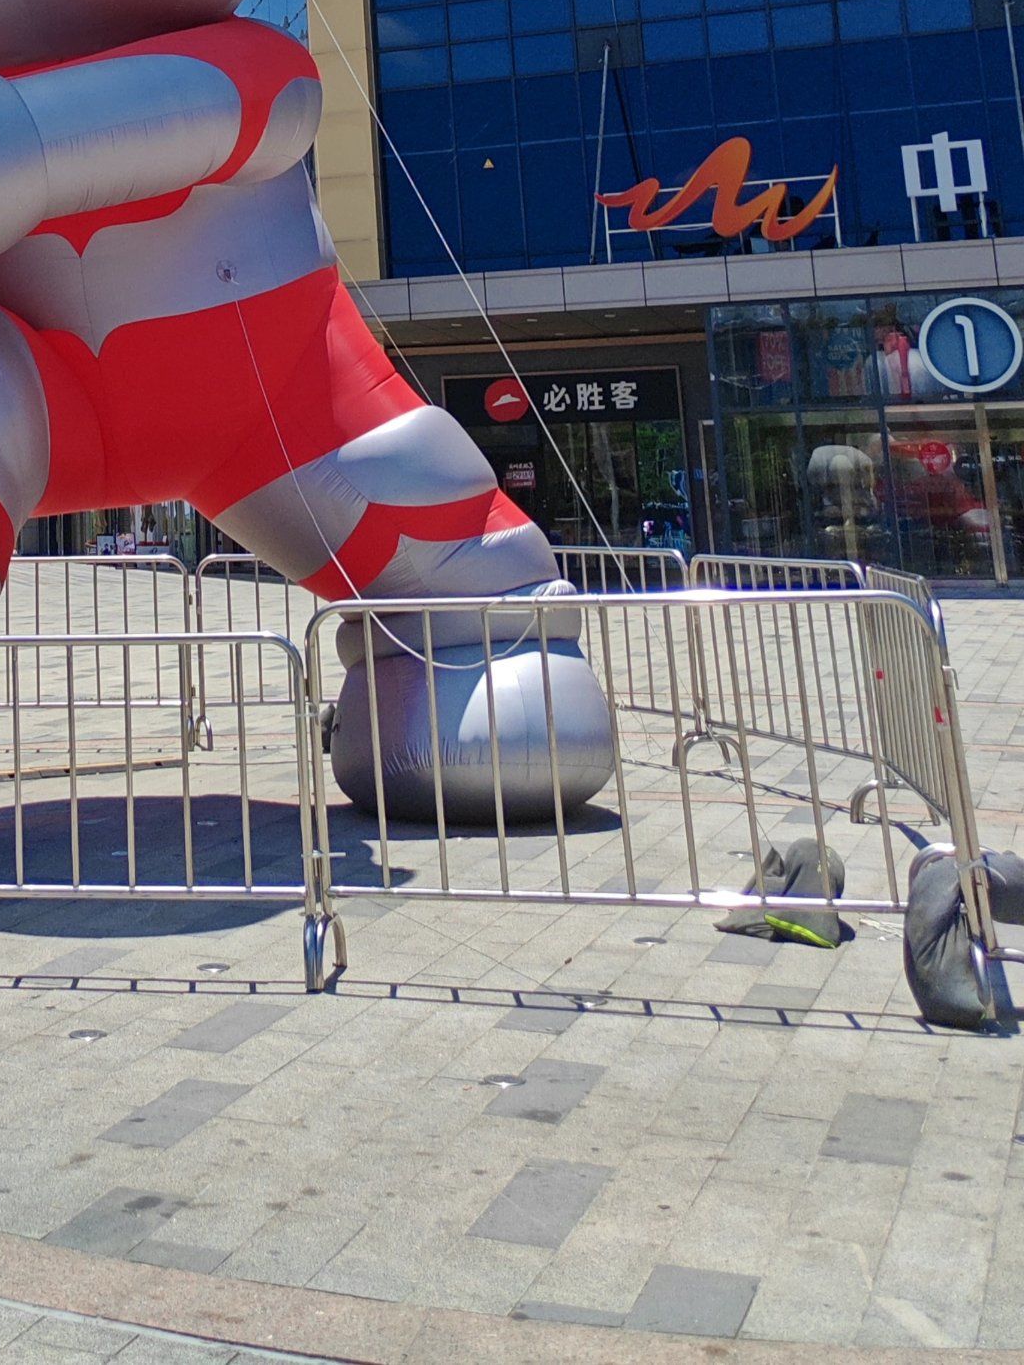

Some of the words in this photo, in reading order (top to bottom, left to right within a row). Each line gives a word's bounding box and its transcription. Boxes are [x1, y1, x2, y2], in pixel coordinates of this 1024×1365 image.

[901, 131, 987, 212] 中
[543, 380, 639, 412] 必胜客
